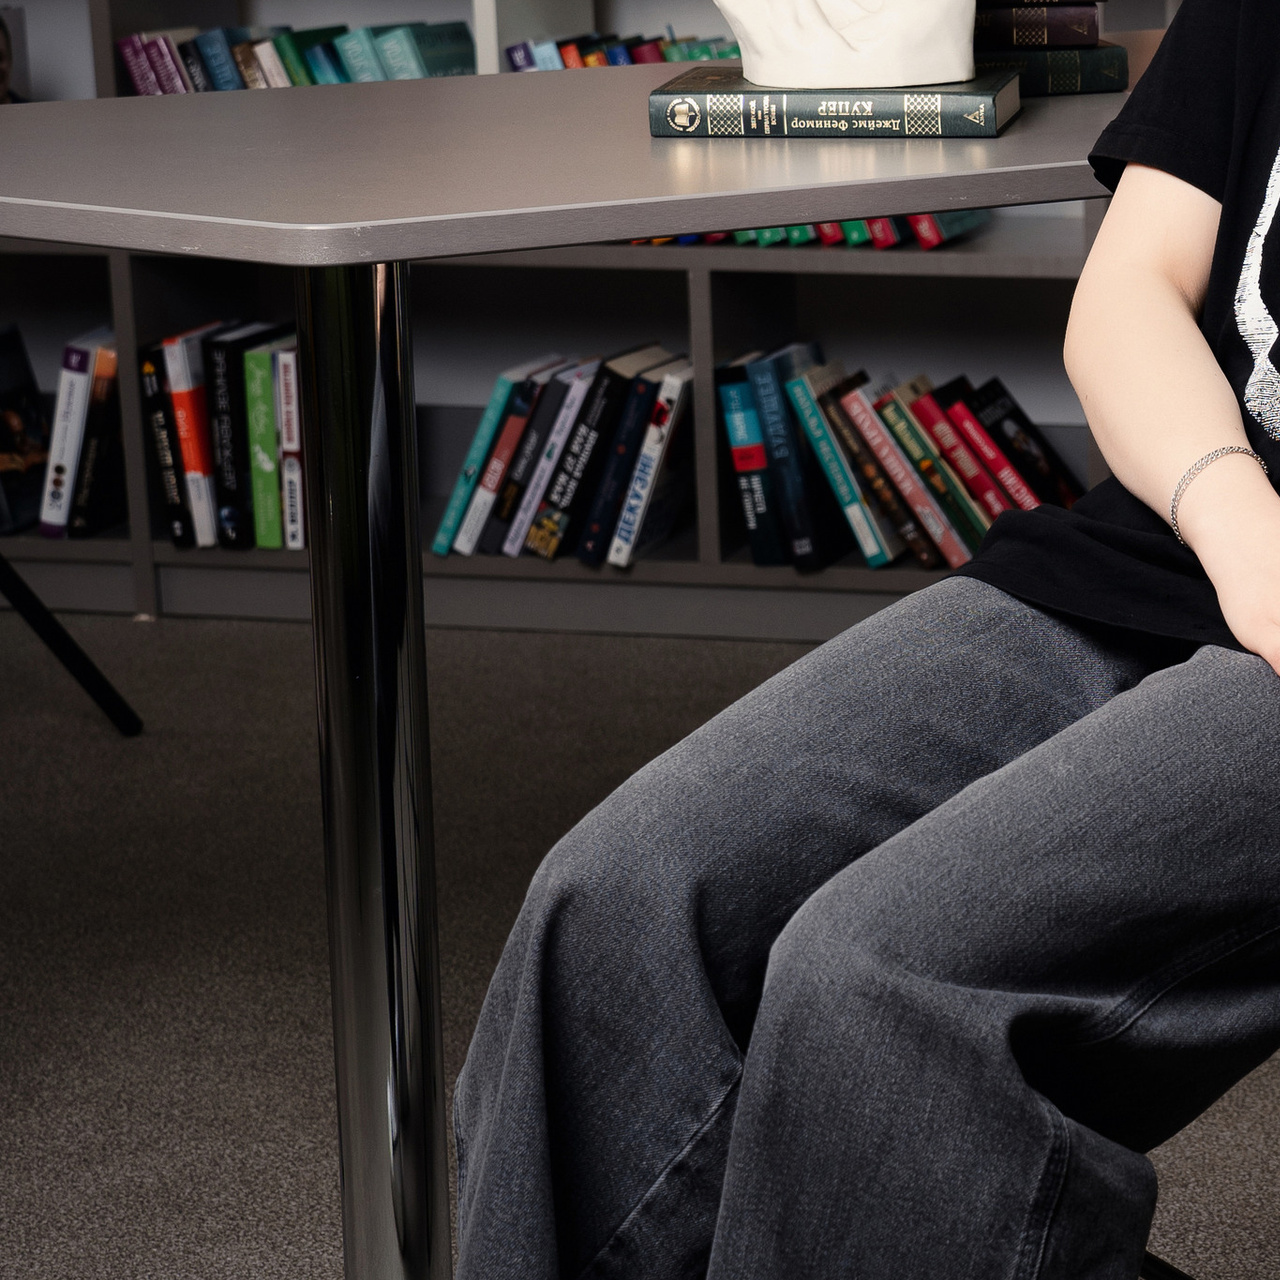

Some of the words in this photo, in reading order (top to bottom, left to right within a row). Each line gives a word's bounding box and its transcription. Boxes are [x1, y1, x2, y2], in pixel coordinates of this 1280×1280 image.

[790, 116, 848, 132] Фенимор
[817, 100, 874, 117] КУПЕР
[851, 116, 901, 132] Джеймс
[213, 350, 231, 411] ЗЕМНЫЕ
[753, 371, 790, 460] БУДУЩЕЕ
[792, 385, 824, 440] НАТАЛЬЯ
[819, 439, 853, 503] НЕСТЕРОВА
[218, 415, 236, 490] ДЕРЖАВЫ
